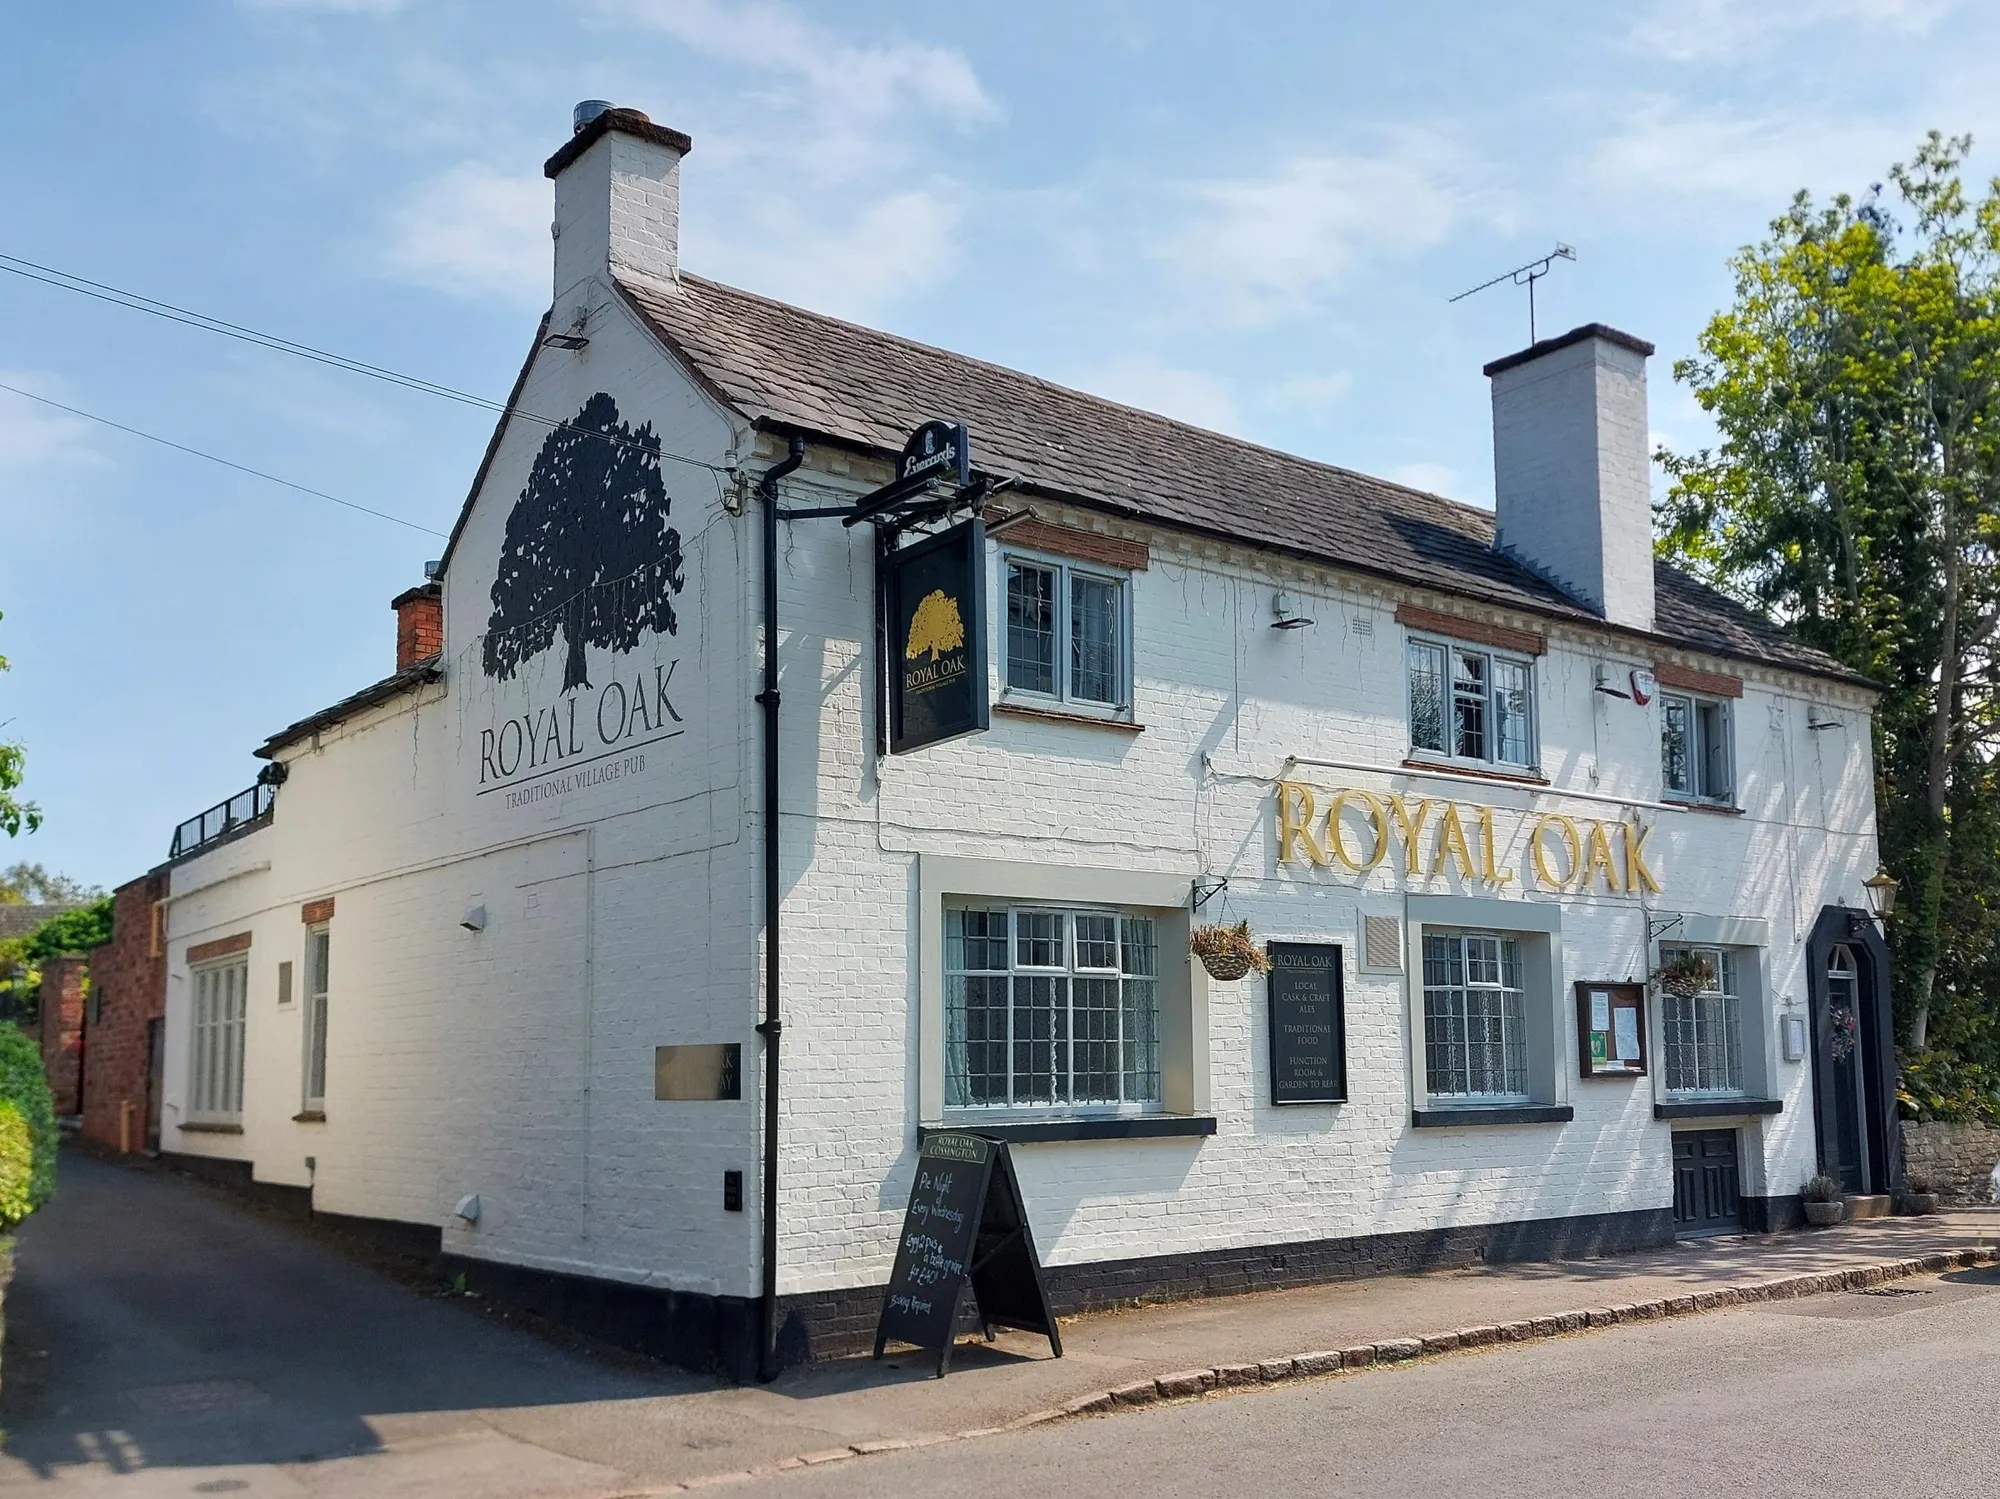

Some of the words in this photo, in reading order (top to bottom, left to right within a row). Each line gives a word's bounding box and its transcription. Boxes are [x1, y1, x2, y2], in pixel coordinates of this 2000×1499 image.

[903, 442, 956, 478] Everards
[906, 664, 939, 688] ROYAL
[941, 655, 966, 675] OAK
[479, 697, 584, 784] ROYAL
[597, 659, 684, 745] OAK
[505, 776, 572, 809] TRADITIONAL
[575, 761, 620, 789] VILLAGE
[624, 754, 645, 776] PUB
[1276, 781, 1513, 882] ROYAL
[1533, 813, 1664, 894] OAK
[1277, 954, 1310, 967] ROYAL
[1311, 955, 1332, 968] OAK
[1294, 981, 1317, 990] LOCAL
[1281, 992, 1300, 1001] CASK
[1302, 993, 1307, 1001] &
[1309, 993, 1330, 1002] CRAFT
[1300, 1004, 1315, 1013] ALES
[1283, 1024, 1331, 1033] TRADITIONAL
[1297, 1036, 1319, 1045] FOOD
[1290, 1056, 1328, 1065] FUNCTION
[1294, 1068, 1316, 1077] ROOM
[1317, 1069, 1324, 1077] &
[1279, 1080, 1308, 1090] GARDEN
[1310, 1080, 1320, 1089] TO
[1322, 1080, 1339, 1088] REAR
[937, 1136, 958, 1147] ROYAL
[959, 1138, 975, 1149] OAK
[929, 1144, 978, 1159] COSSINGTON
[911, 1198, 929, 1226] Every
[931, 1203, 965, 1234] Wednesday
